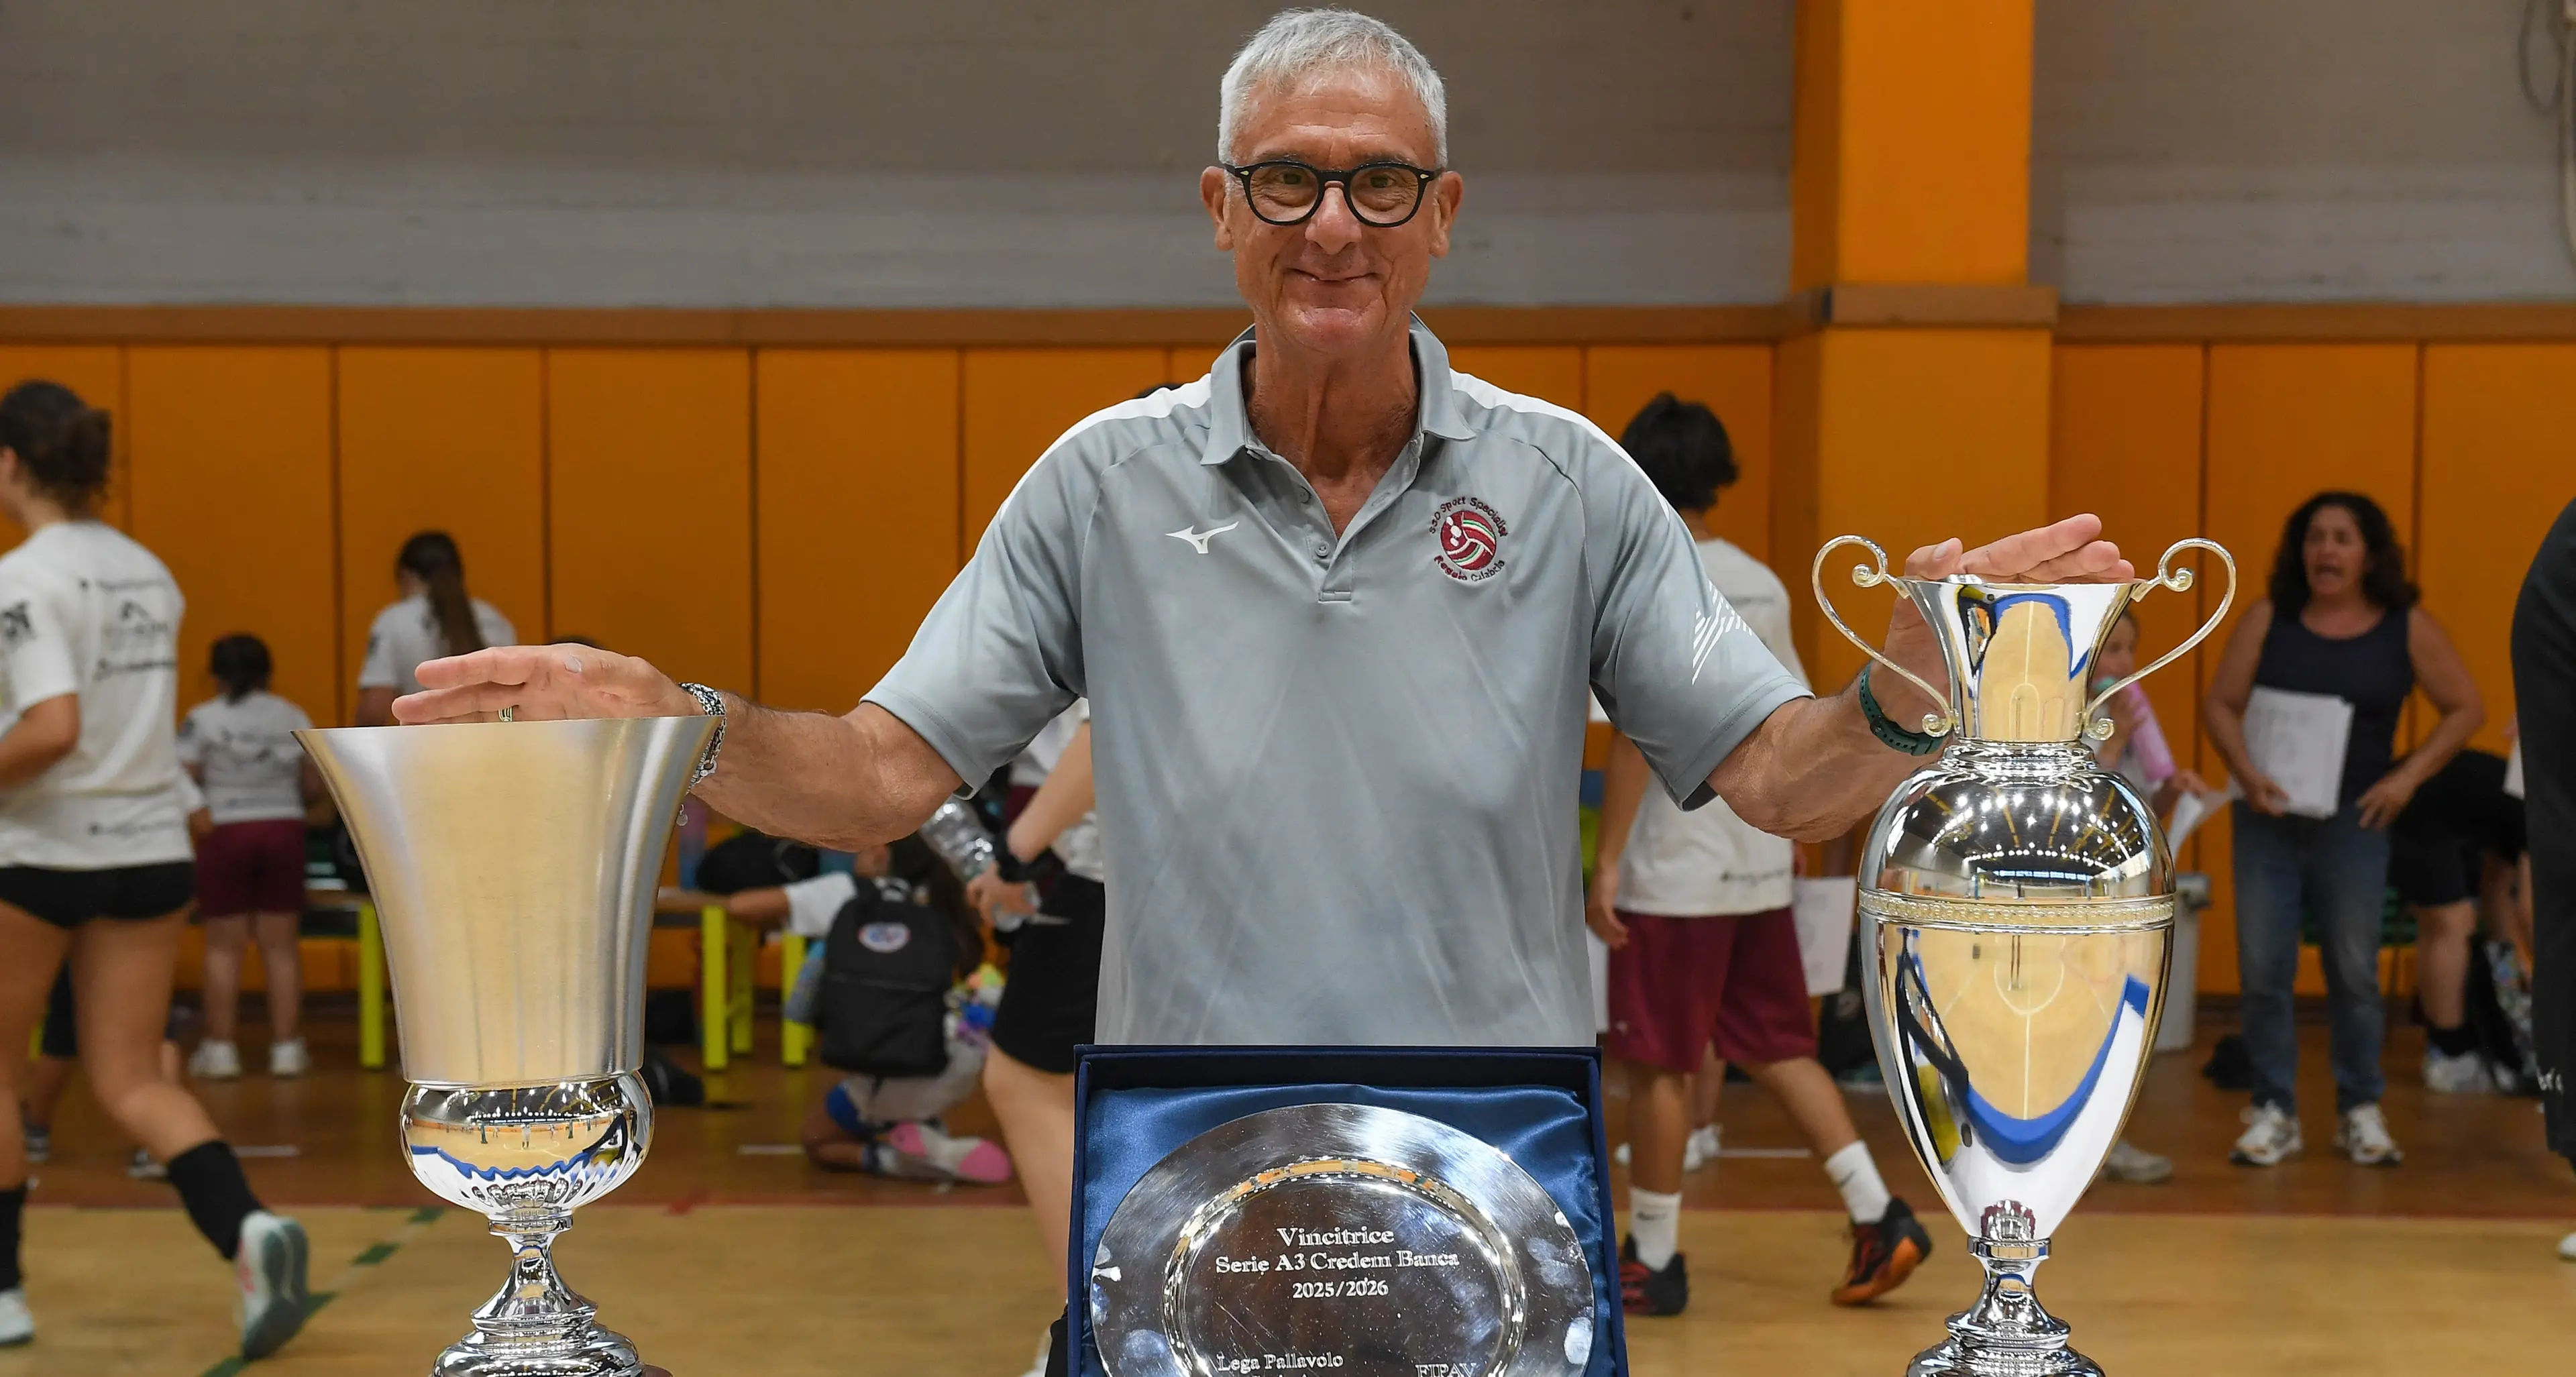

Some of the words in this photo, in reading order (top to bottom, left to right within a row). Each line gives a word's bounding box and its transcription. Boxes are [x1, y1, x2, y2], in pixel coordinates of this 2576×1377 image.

[1440, 496, 1466, 512] Sport
[1470, 497, 1508, 537] Specialist
[1277, 1226, 1395, 1247] Vincitrice
[1216, 1255, 1270, 1273] Serie
[1275, 1252, 1306, 1272] A3
[1310, 1251, 1392, 1270] Credem
[1395, 1250, 1460, 1267] Banca
[1292, 1280, 1389, 1299] 2025/2026
[1217, 1352, 1260, 1374] Lega
[1264, 1351, 1344, 1369] Pallavolo
[1415, 1362, 1477, 1377] FIPAV
